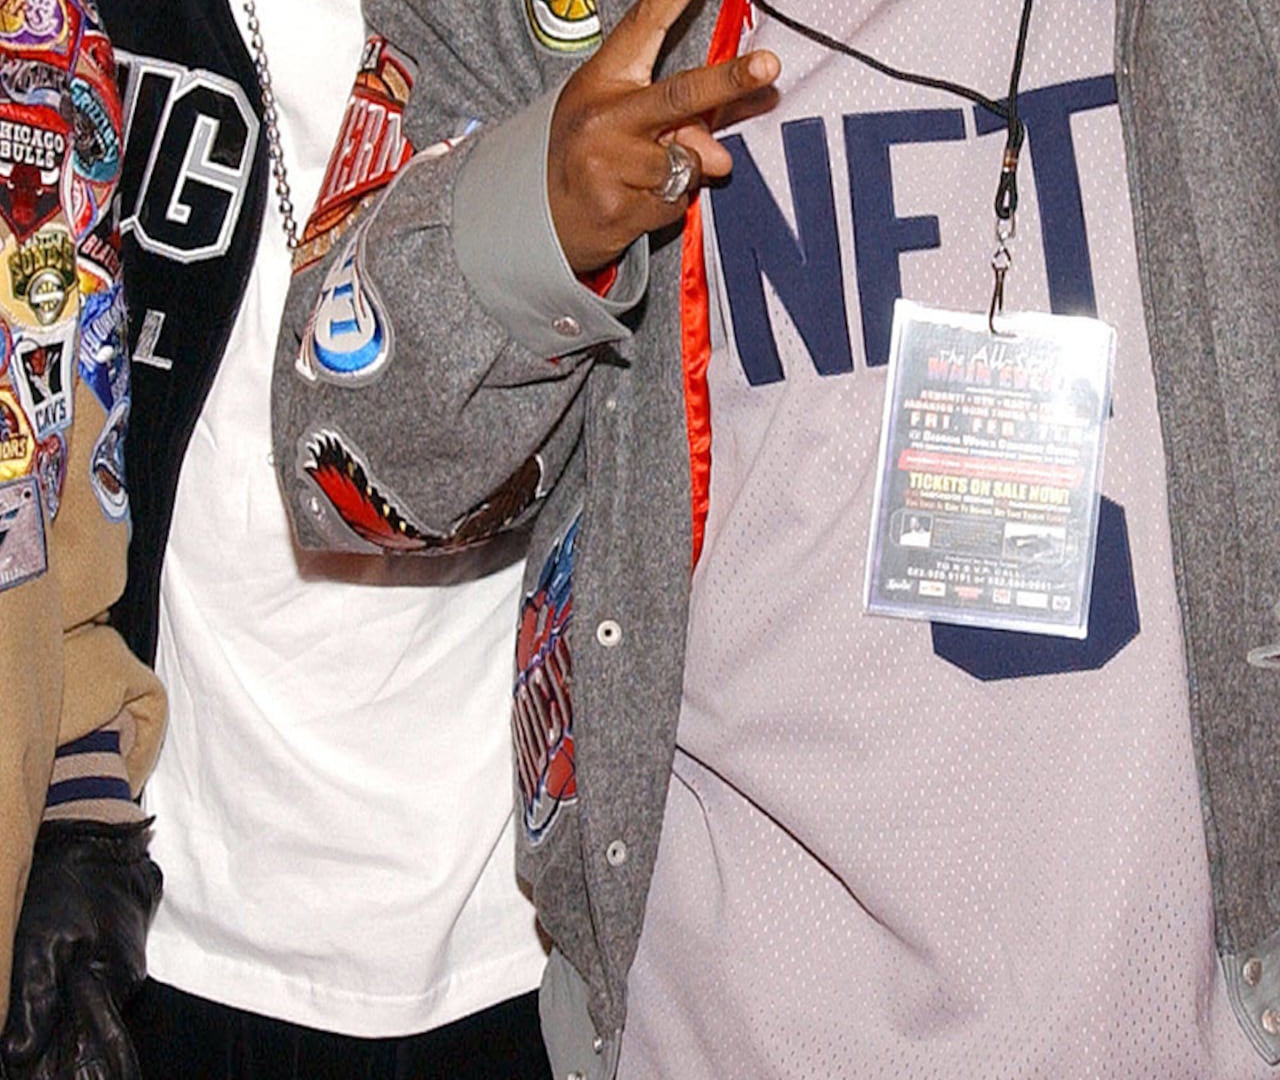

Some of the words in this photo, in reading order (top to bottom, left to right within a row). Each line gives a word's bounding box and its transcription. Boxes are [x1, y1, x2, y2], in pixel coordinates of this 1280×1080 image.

[0, 139, 57, 167] BULLS
[909, 472, 968, 494] TICKETS
[971, 477, 991, 496] ON
[993, 481, 1028, 501] SALE
